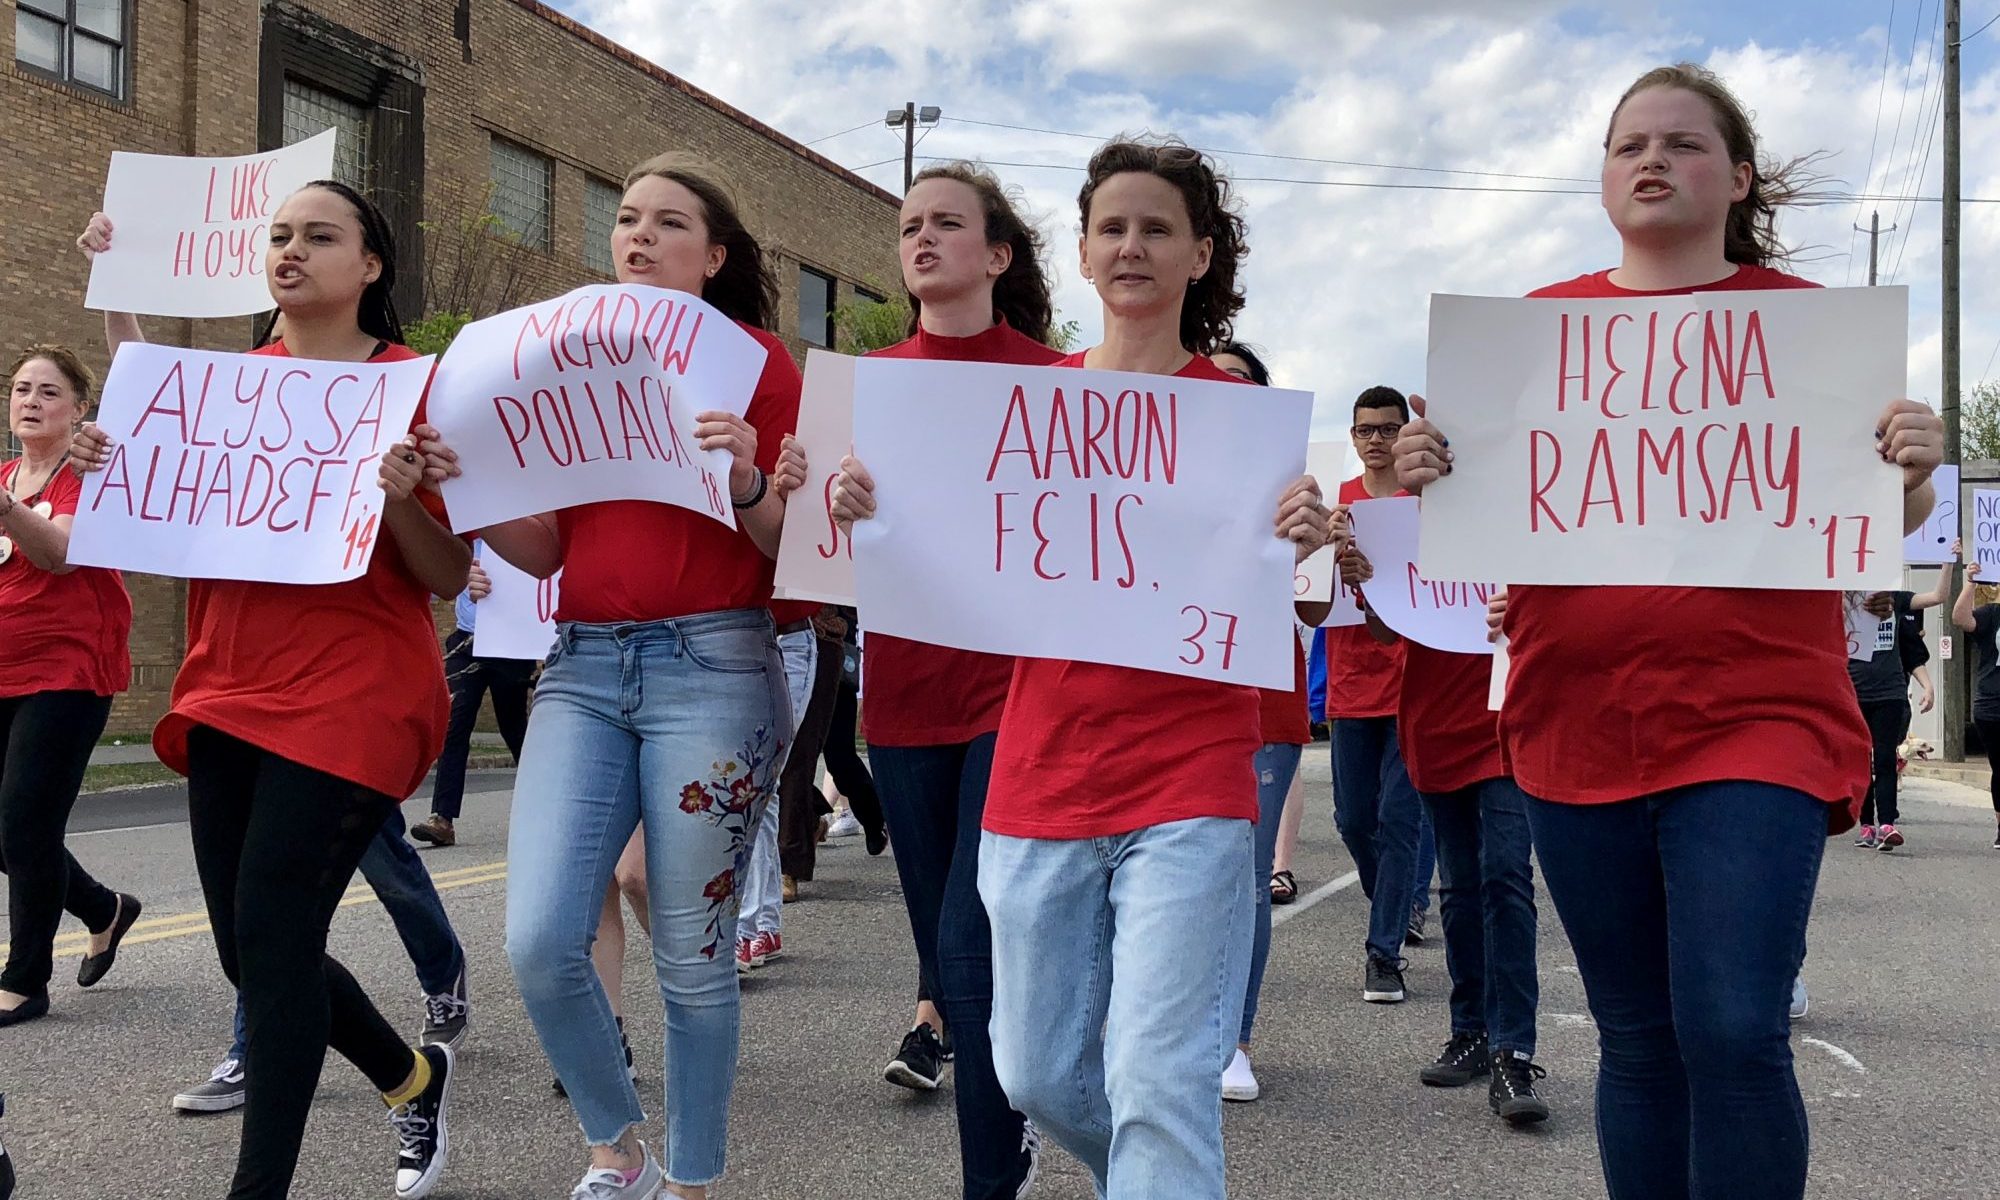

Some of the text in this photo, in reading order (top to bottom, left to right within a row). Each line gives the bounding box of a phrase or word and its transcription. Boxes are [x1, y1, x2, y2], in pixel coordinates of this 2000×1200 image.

[204, 158, 278, 224] LUKE
[173, 223, 264, 278] HOYE
[513, 292, 703, 380] MEADOW
[1557, 309, 1776, 418] HELENA
[132, 359, 388, 457] ALYSSA
[986, 384, 1177, 485] AARON
[700, 466, 726, 517] 18
[343, 512, 377, 571] 14
[1178, 604, 1239, 671] 37
